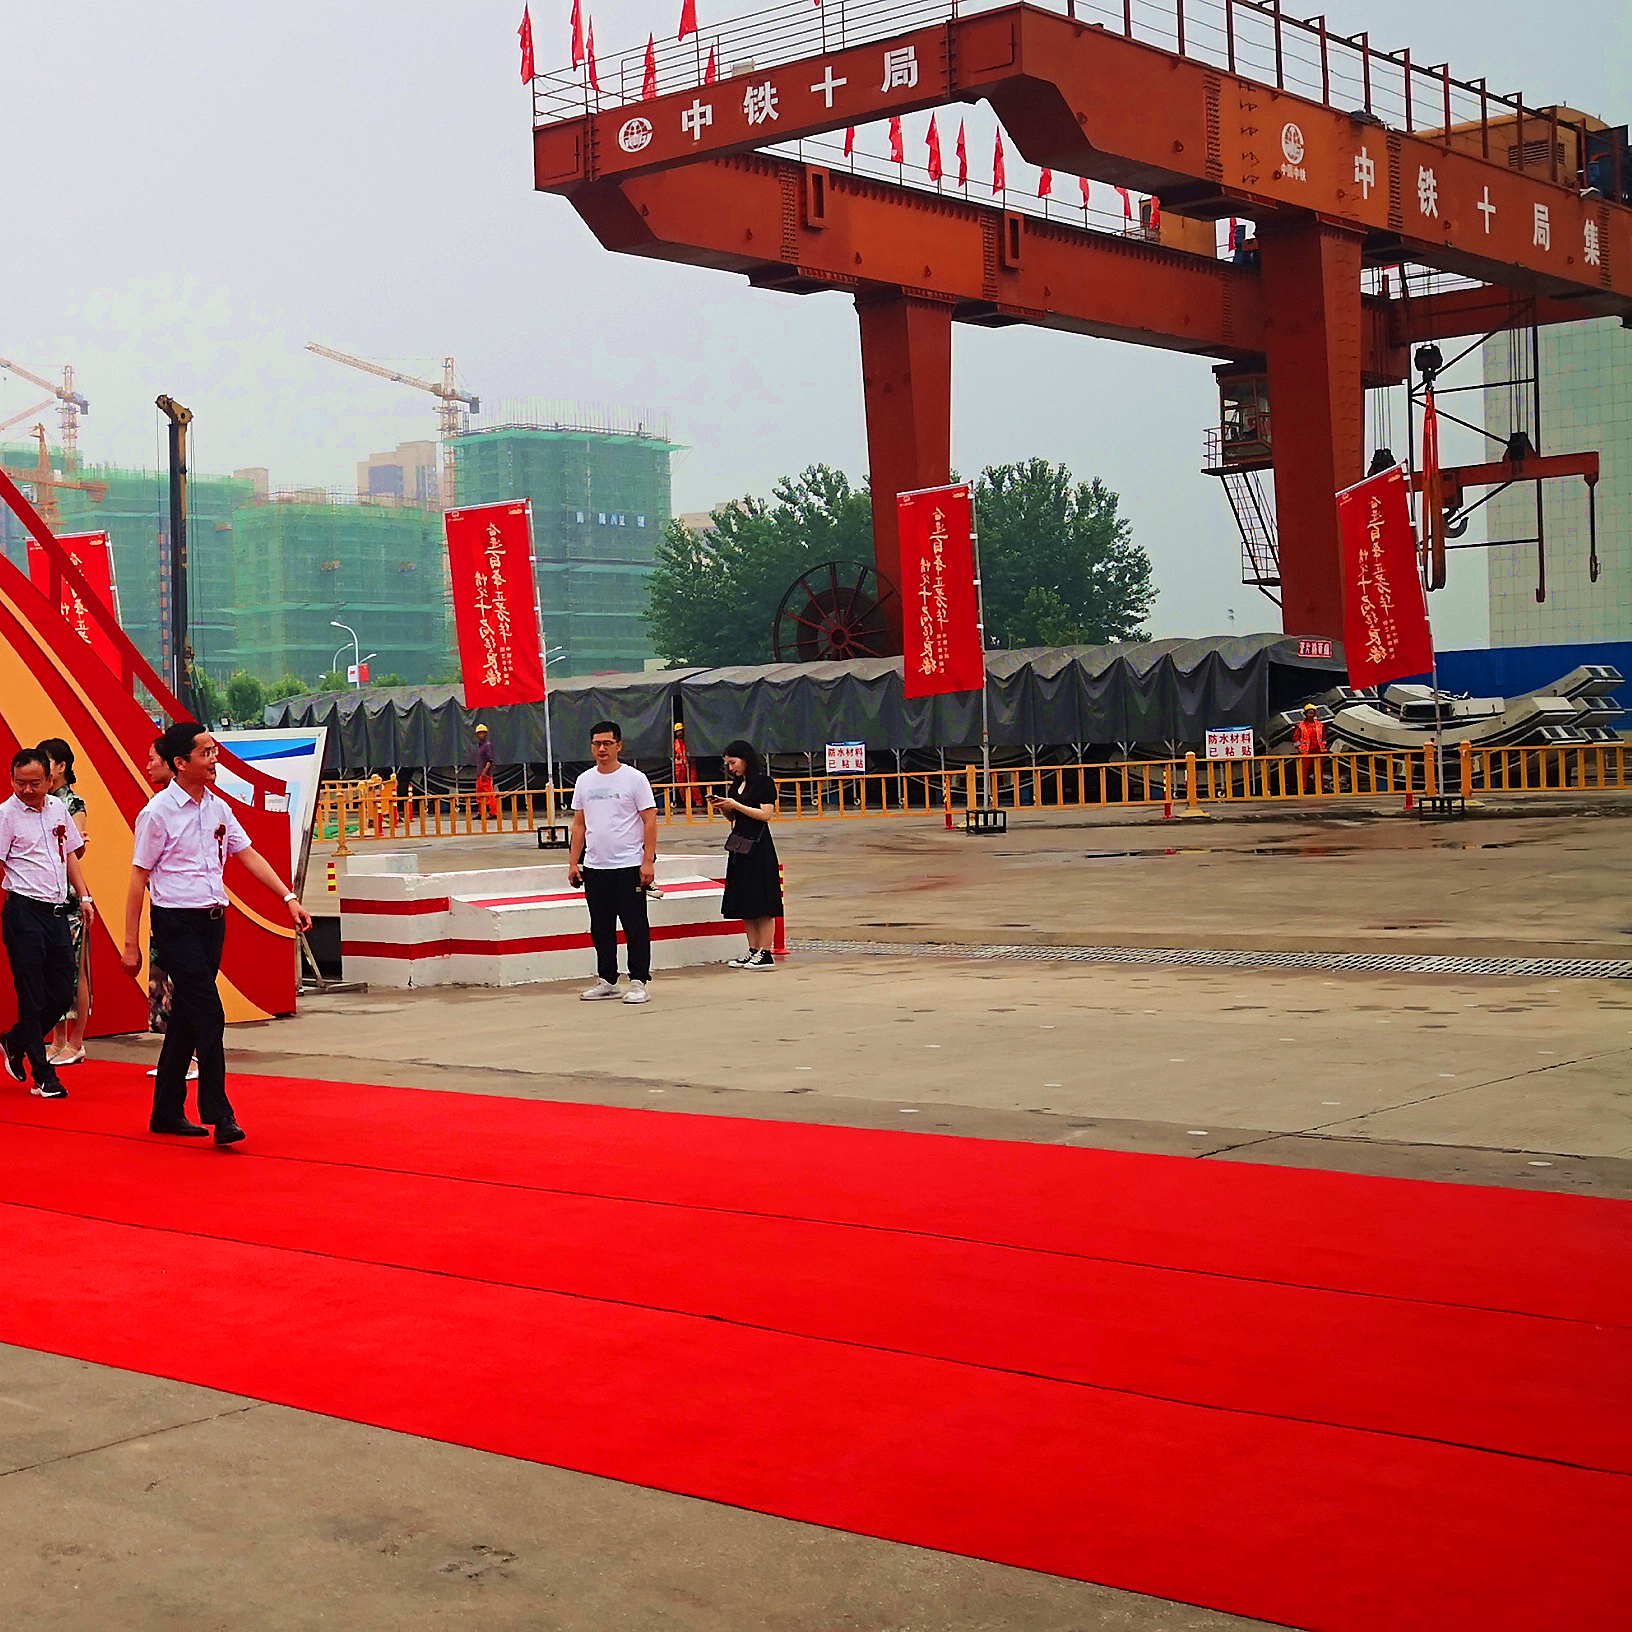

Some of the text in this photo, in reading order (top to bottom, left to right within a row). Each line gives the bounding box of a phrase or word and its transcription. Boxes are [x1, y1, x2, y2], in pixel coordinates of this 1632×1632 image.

[680, 45, 919, 142] 中铁十局
[1354, 146, 1601, 267] 中铁十局集
[1208, 733, 1251, 744] 防水材料
[828, 747, 863, 757] 防水材料
[1209, 746, 1252, 757] 已粘贴
